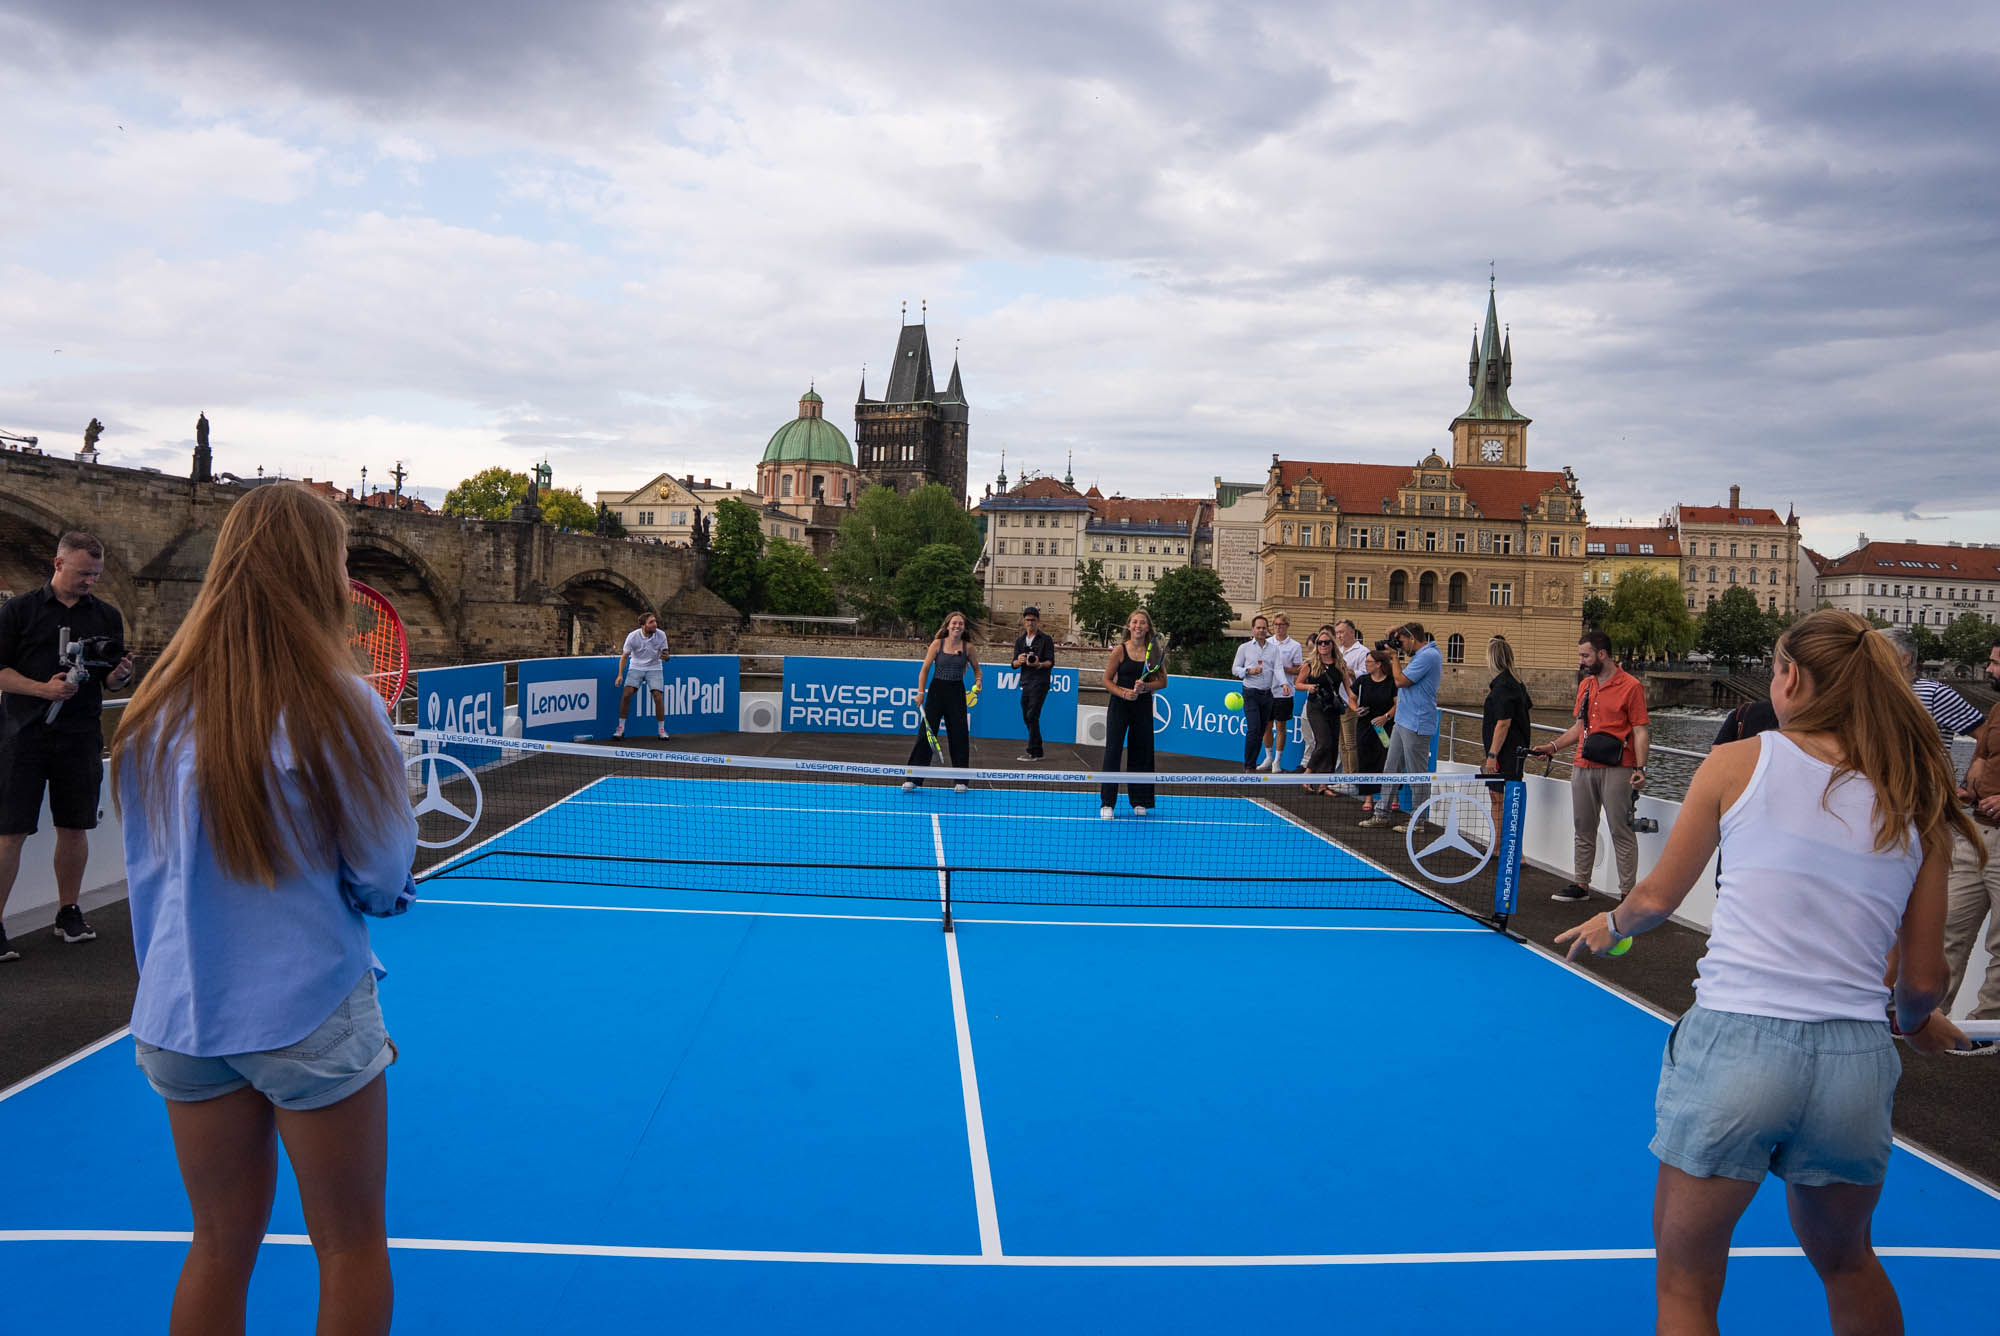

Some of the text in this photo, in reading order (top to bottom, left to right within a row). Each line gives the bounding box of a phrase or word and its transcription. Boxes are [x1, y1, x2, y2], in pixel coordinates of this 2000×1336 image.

[1049, 675, 1071, 693] 50
[531, 692, 590, 715] Lenovo
[636, 676, 725, 717] ThnkPad
[443, 691, 497, 747] AGEL
[789, 706, 895, 729] PRAGUE
[436, 733, 545, 750] LIVESPORT PRAGUE OPEN
[615, 750, 663, 759] LIVESPORT
[665, 754, 700, 762] PRAGUE
[795, 762, 845, 771] LIVESPORT
[846, 766, 881, 774] PRAGUE
[976, 772, 1025, 780] LIVESPORT
[1155, 775, 1262, 783] LIVESPORT PRAGUE OPEN
[1502, 786, 1521, 901] LIVESPORT PRAGUE OPEN
